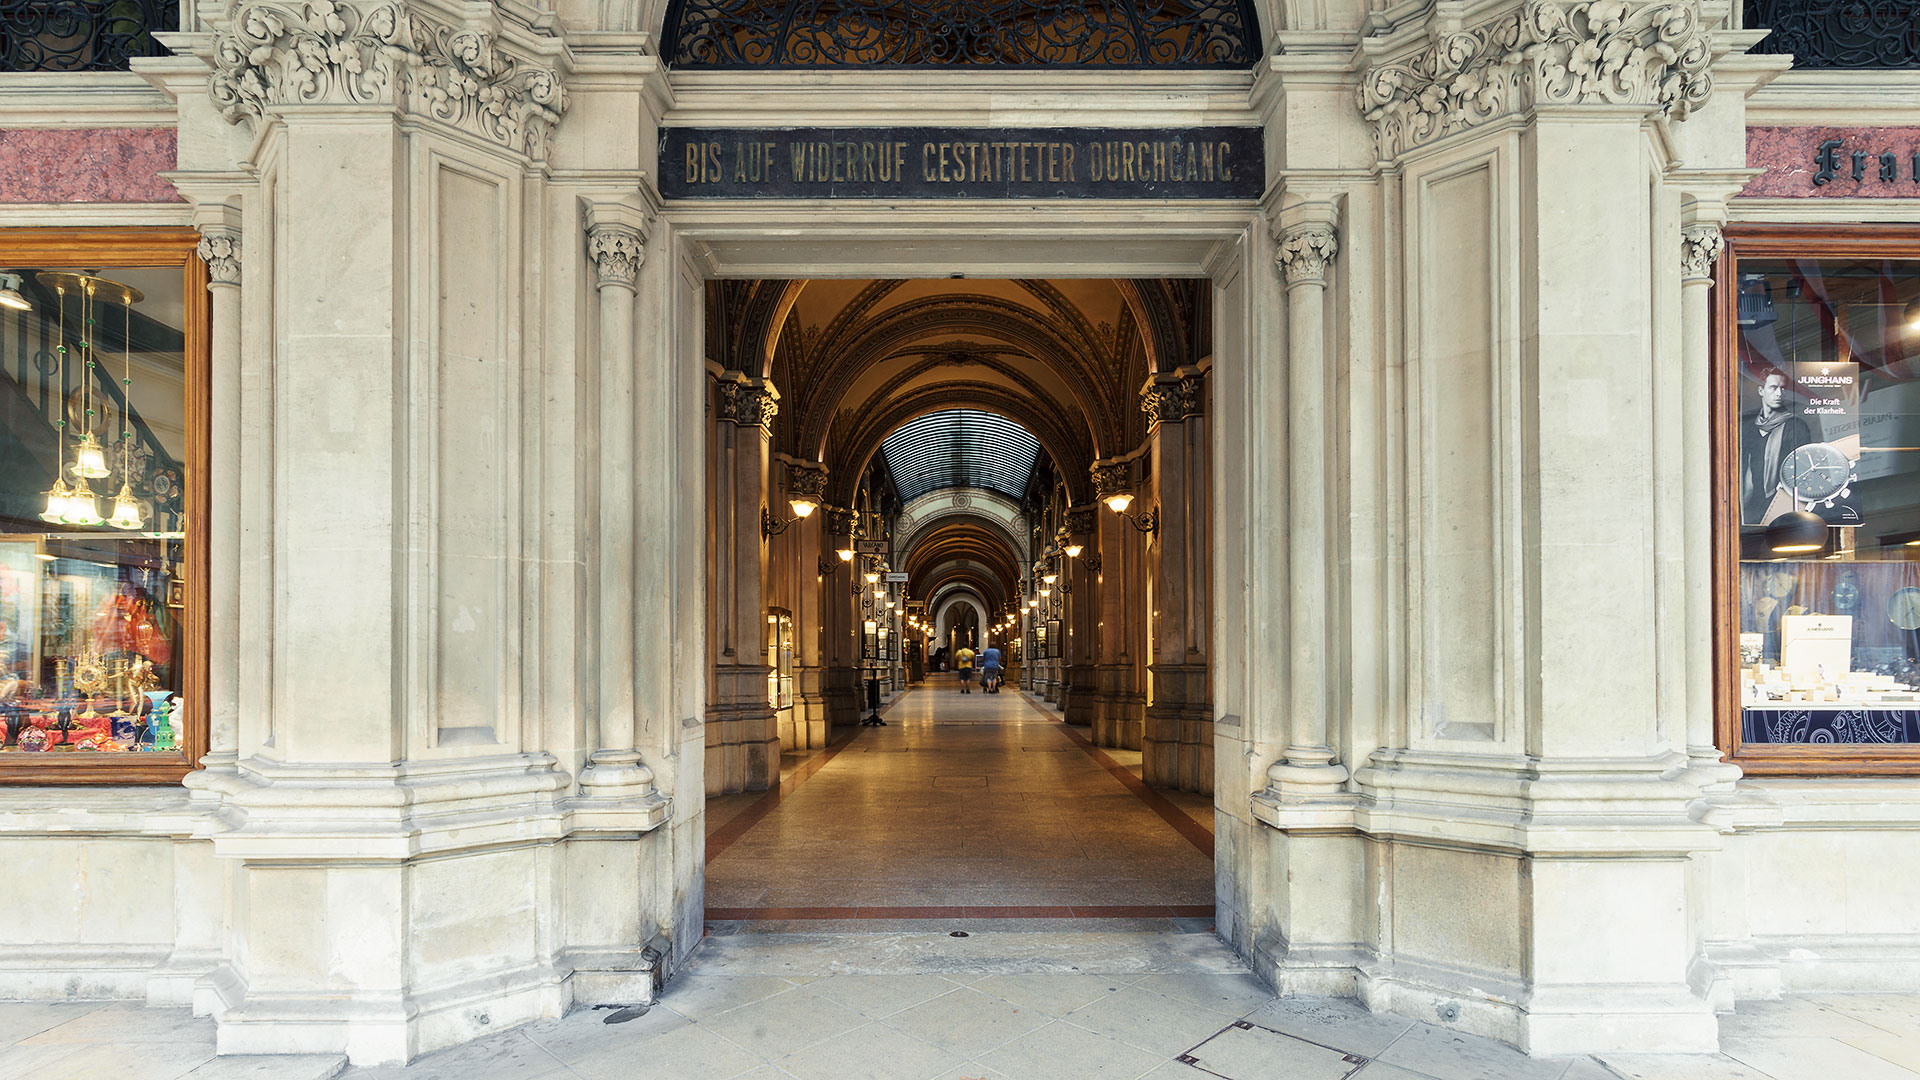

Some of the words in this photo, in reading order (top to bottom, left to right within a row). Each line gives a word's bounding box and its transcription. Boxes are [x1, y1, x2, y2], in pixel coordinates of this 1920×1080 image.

[685, 142, 722, 183] BIS
[734, 142, 776, 183] AUF
[789, 141, 907, 183] WIDERRUF
[922, 142, 1076, 183] GESTATTETER
[1797, 376, 1853, 385] JUNGHANS
[1810, 398, 1822, 406] Die
[1822, 398, 1841, 406] Kraft
[1803, 407, 1815, 415] der
[1816, 407, 1847, 415] Klarheit.
